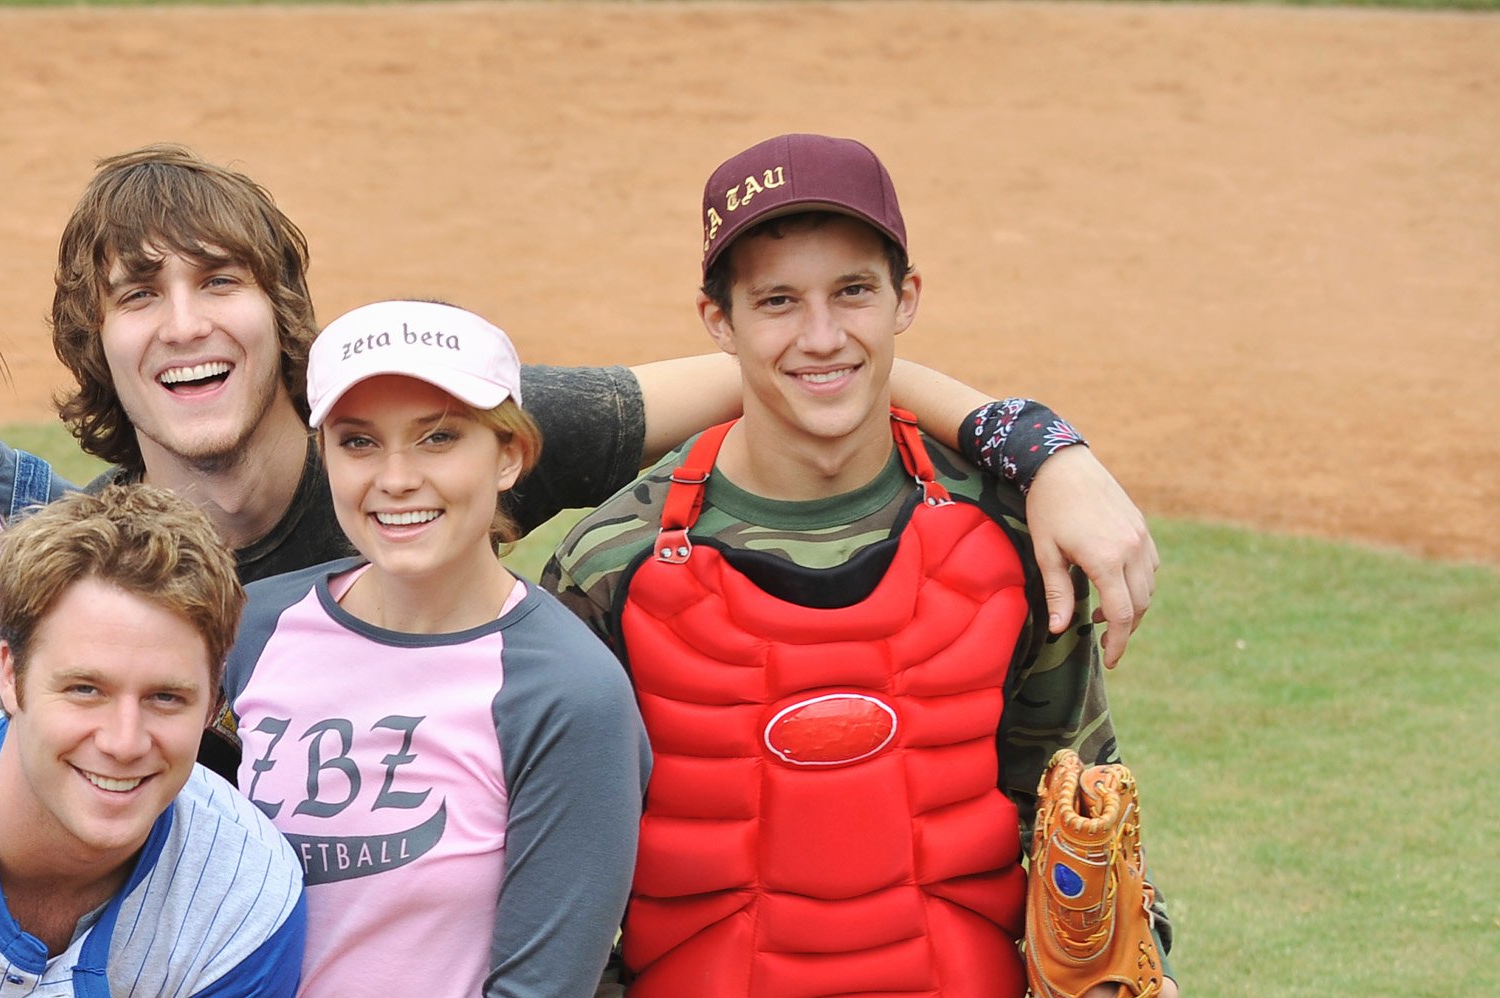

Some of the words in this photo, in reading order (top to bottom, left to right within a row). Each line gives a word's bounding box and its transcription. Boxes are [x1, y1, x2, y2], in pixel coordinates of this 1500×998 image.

[725, 166, 786, 212] TAU
[341, 331, 392, 361] zeta
[402, 322, 461, 351] beta
[300, 837, 411, 875] FTBALL
